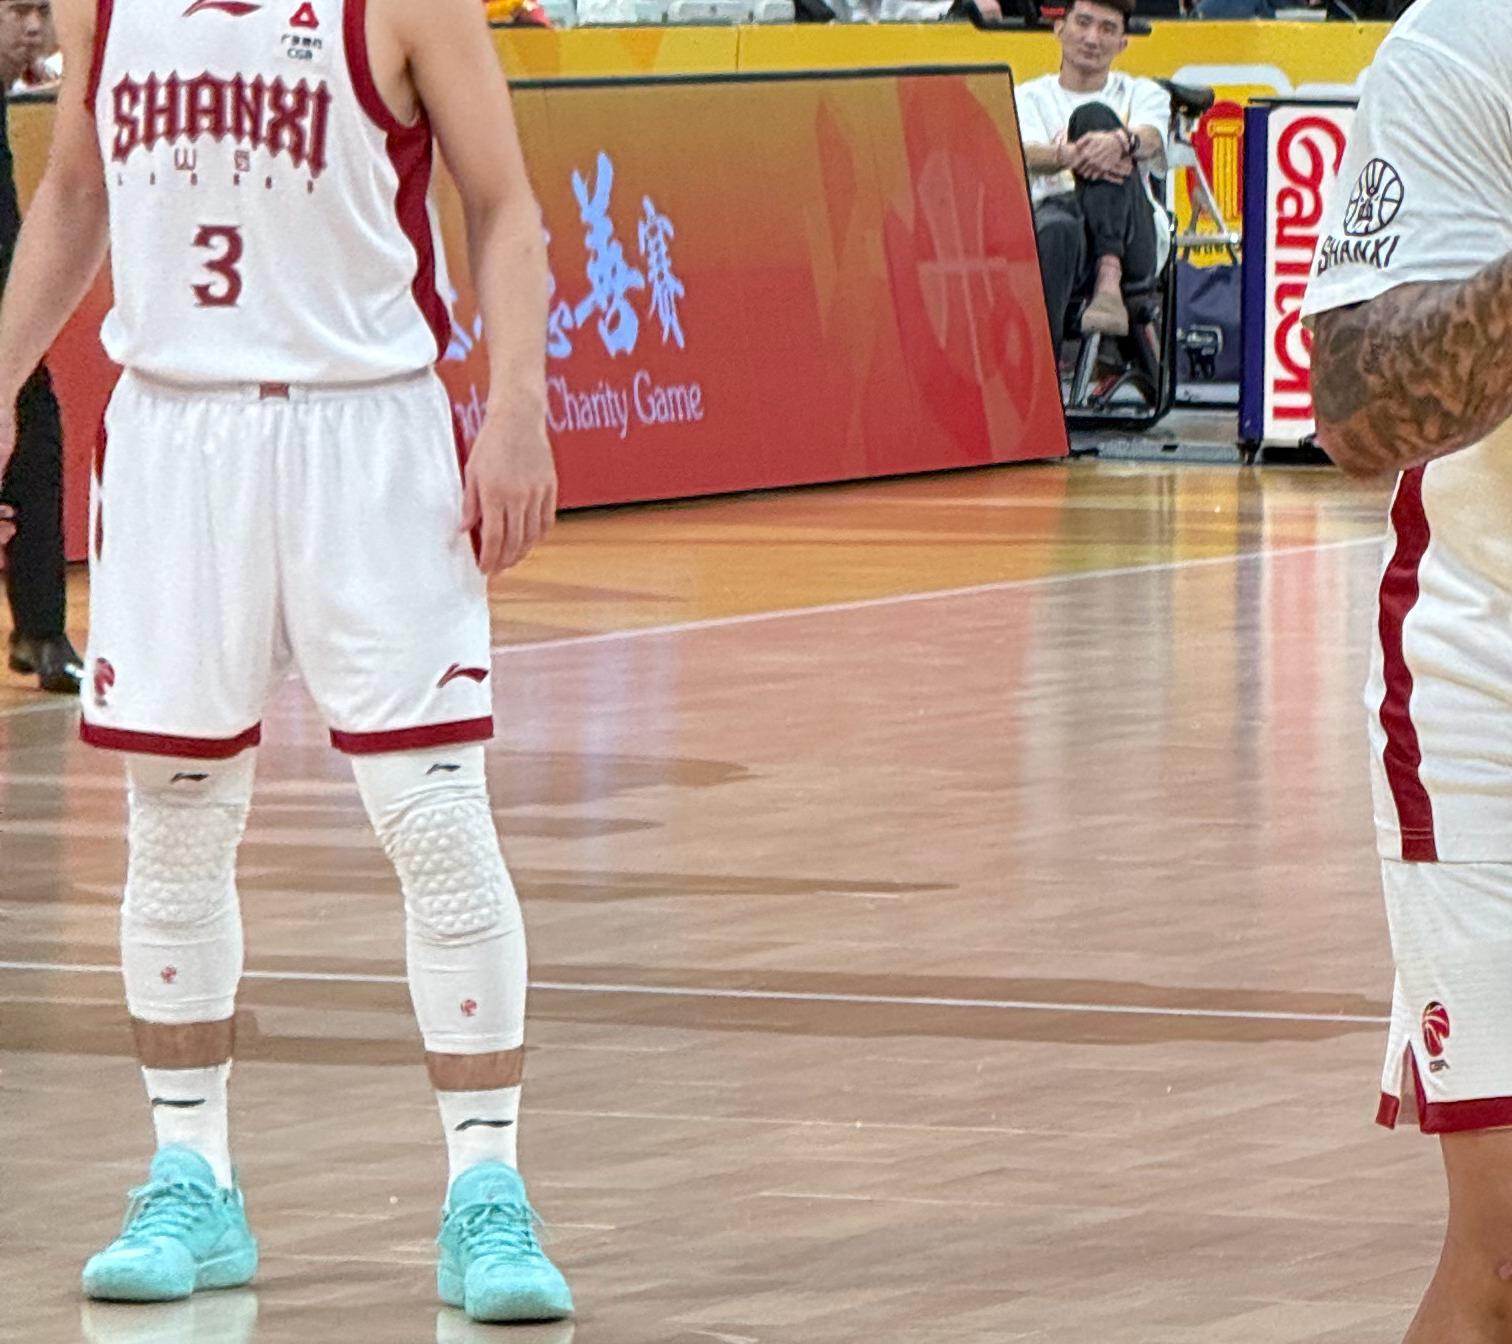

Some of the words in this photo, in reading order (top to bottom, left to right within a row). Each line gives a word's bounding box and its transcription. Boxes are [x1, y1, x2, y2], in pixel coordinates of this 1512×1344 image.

[111, 70, 332, 179] SHANXI
[190, 223, 243, 308] 3
[546, 150, 685, 358] 善赛
[1317, 234, 1400, 277] SHANXI
[546, 374, 628, 440] Charity
[633, 370, 704, 429] Game
